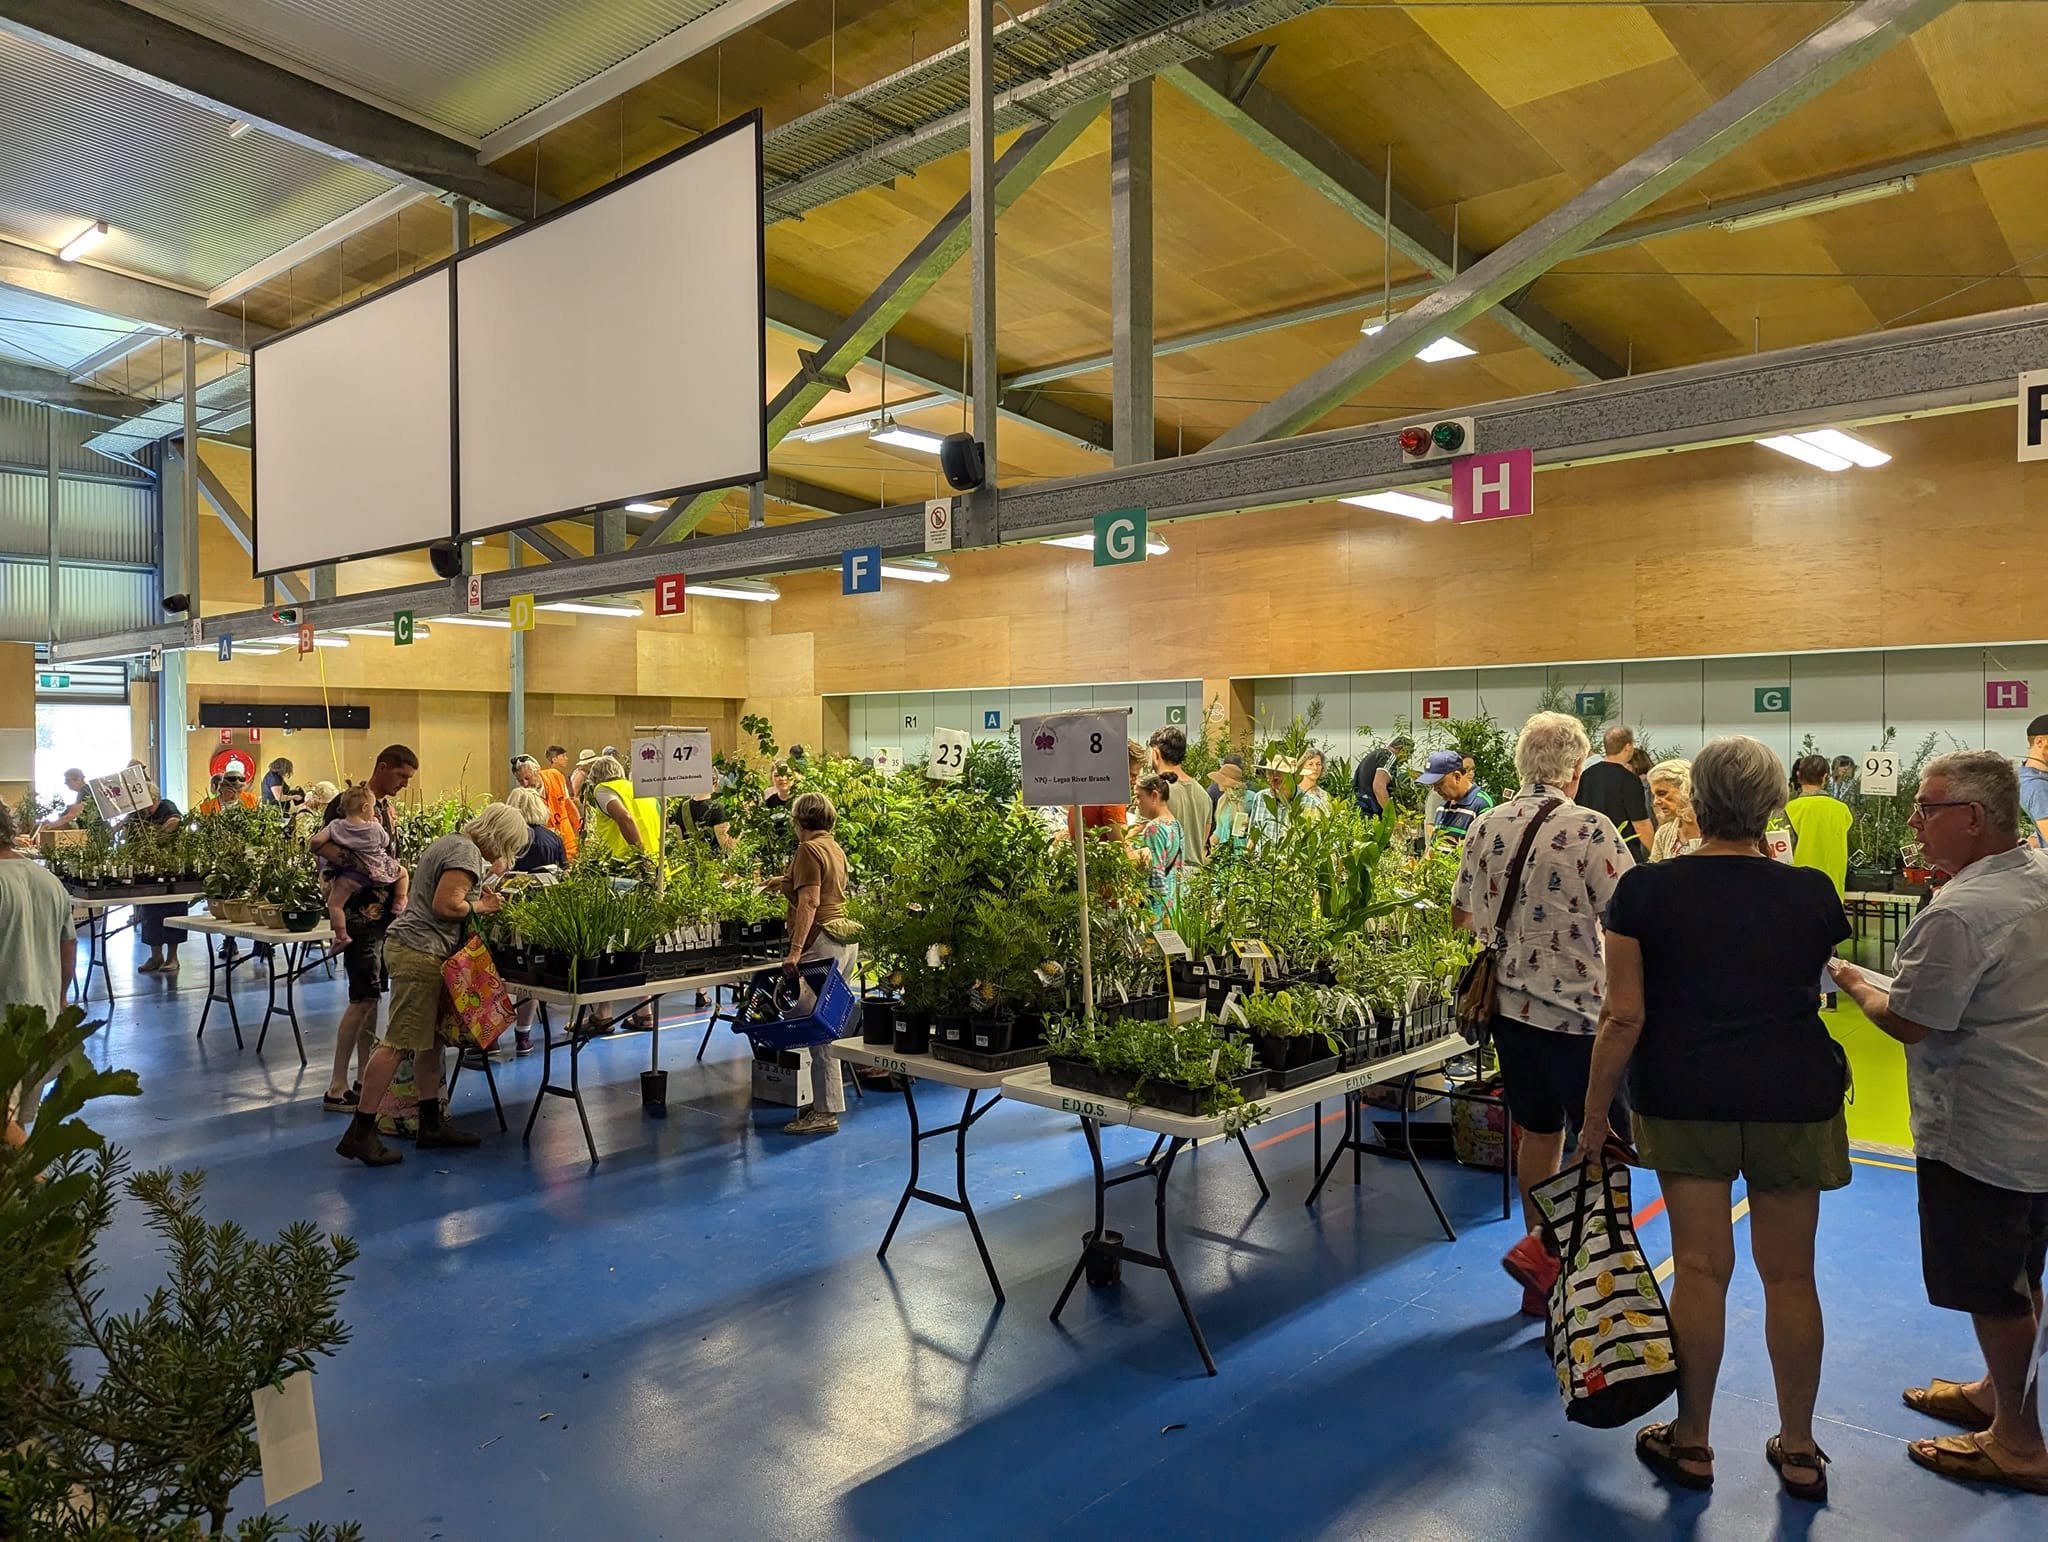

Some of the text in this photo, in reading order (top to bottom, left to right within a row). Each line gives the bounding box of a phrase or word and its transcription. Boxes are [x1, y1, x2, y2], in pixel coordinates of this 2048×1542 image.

[1473, 463, 1510, 514] H
[1106, 519, 1135, 559] G
[852, 555, 868, 590] F
[663, 581, 677, 611] E
[516, 601, 528, 627] D
[398, 616, 408, 640] C
[221, 640, 230, 659] A
[302, 629, 310, 651] B
[151, 647, 161, 667] R1
[1763, 691, 1782, 710] G
[1997, 685, 2016, 706] H
[1170, 709, 1181, 723] C
[1429, 701, 1442, 717] E
[905, 716, 917, 728] R1
[987, 713, 997, 726] A
[1090, 732, 1103, 754] 8
[672, 746, 693, 761] 47
[892, 759, 900, 767] 35
[936, 743, 963, 768] 23
[1866, 758, 1893, 777] 93
[132, 783, 143, 794] 43
